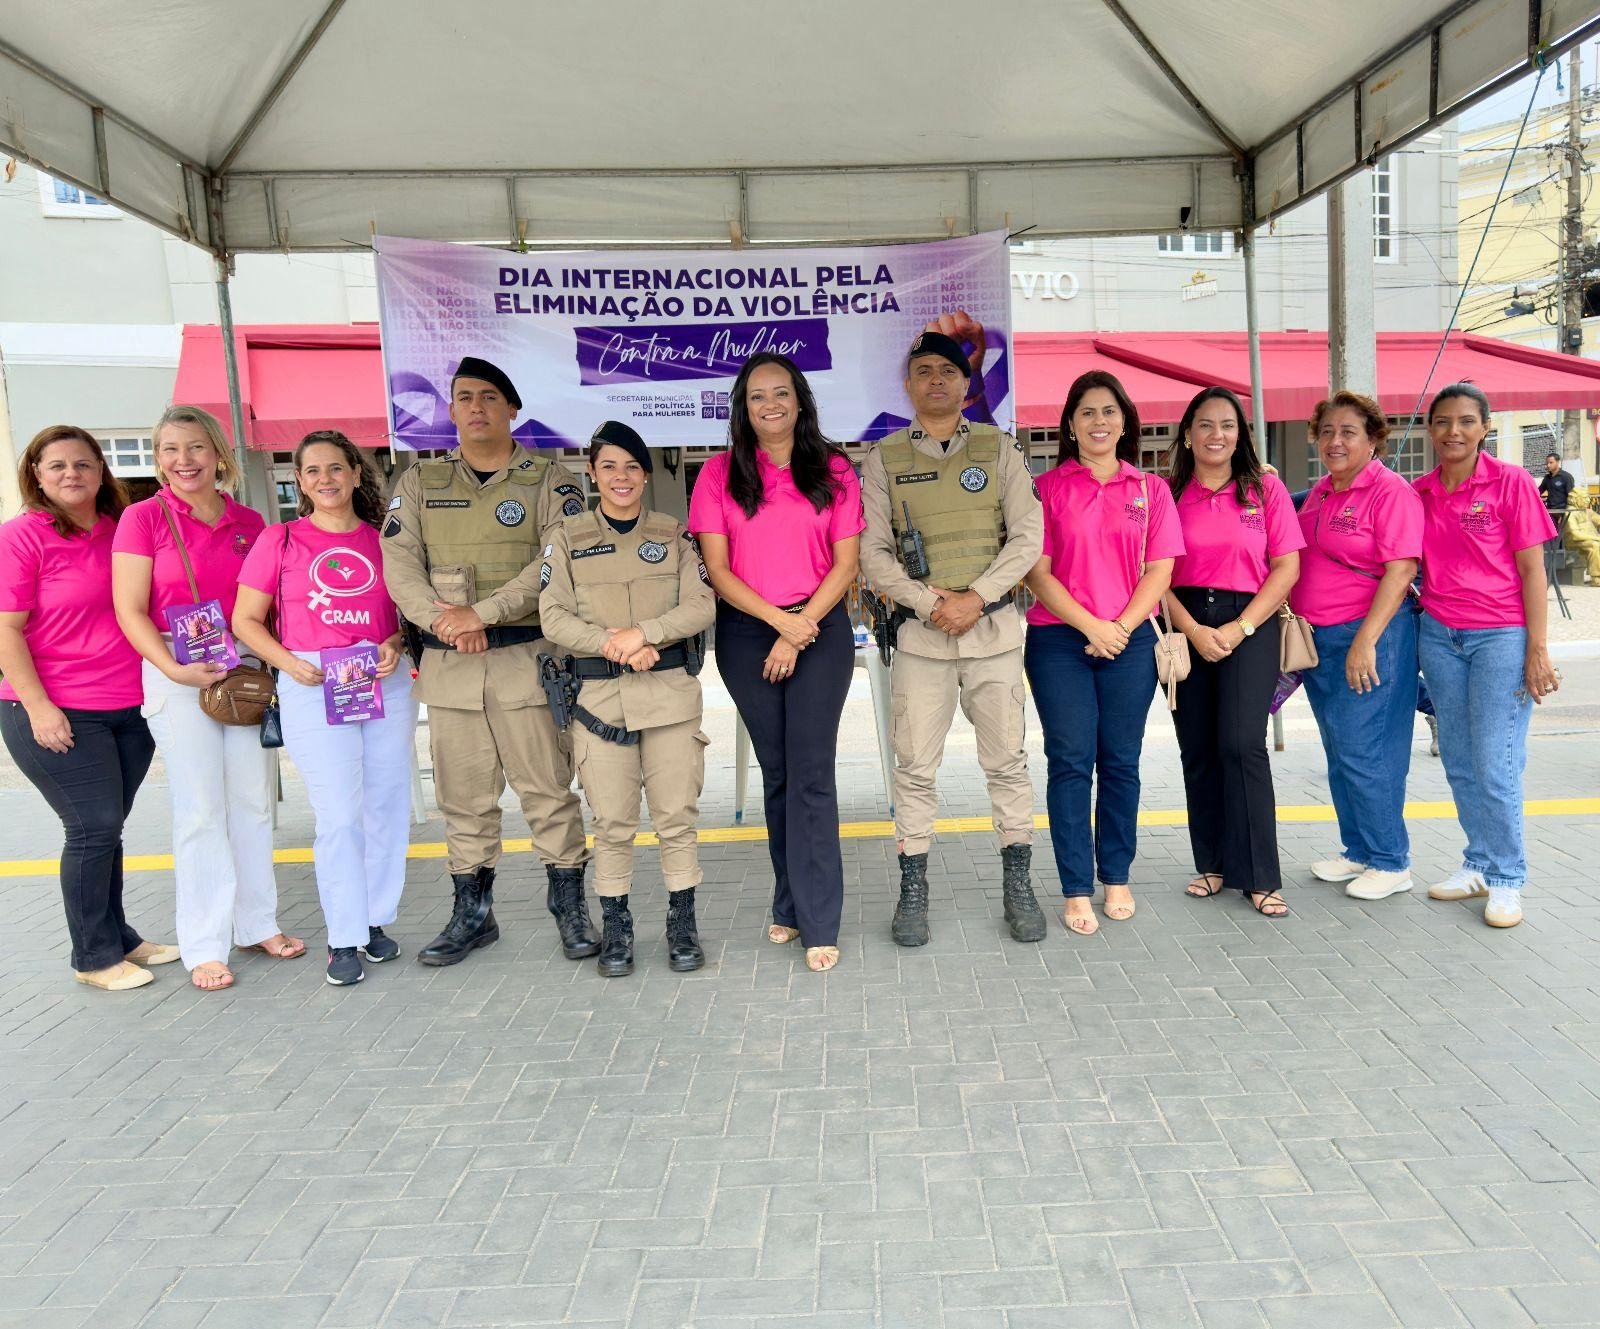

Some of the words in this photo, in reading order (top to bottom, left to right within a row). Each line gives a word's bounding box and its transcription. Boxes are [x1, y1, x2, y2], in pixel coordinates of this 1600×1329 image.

[499, 267, 553, 288] DIA
[562, 267, 808, 290] INTERNACIONAL
[816, 264, 894, 287] PELA
[940, 281, 964, 292] NÃO
[438, 296, 462, 307] NÃO
[942, 292, 965, 303] NÃO
[494, 291, 685, 322] ELIMINAÇÃO
[694, 296, 734, 316] DA
[741, 288, 900, 316] VIOLÊNCIA
[912, 306, 938, 316] CALE
[967, 304, 980, 312] SE
[438, 308, 463, 319] NÃO
[440, 319, 464, 330] NÃO
[598, 333, 677, 376] Contra
[682, 345, 700, 360] a
[706, 326, 807, 366] Mulher
[654, 394, 694, 402] MUNICIPAL
[320, 609, 370, 624] CRAM
